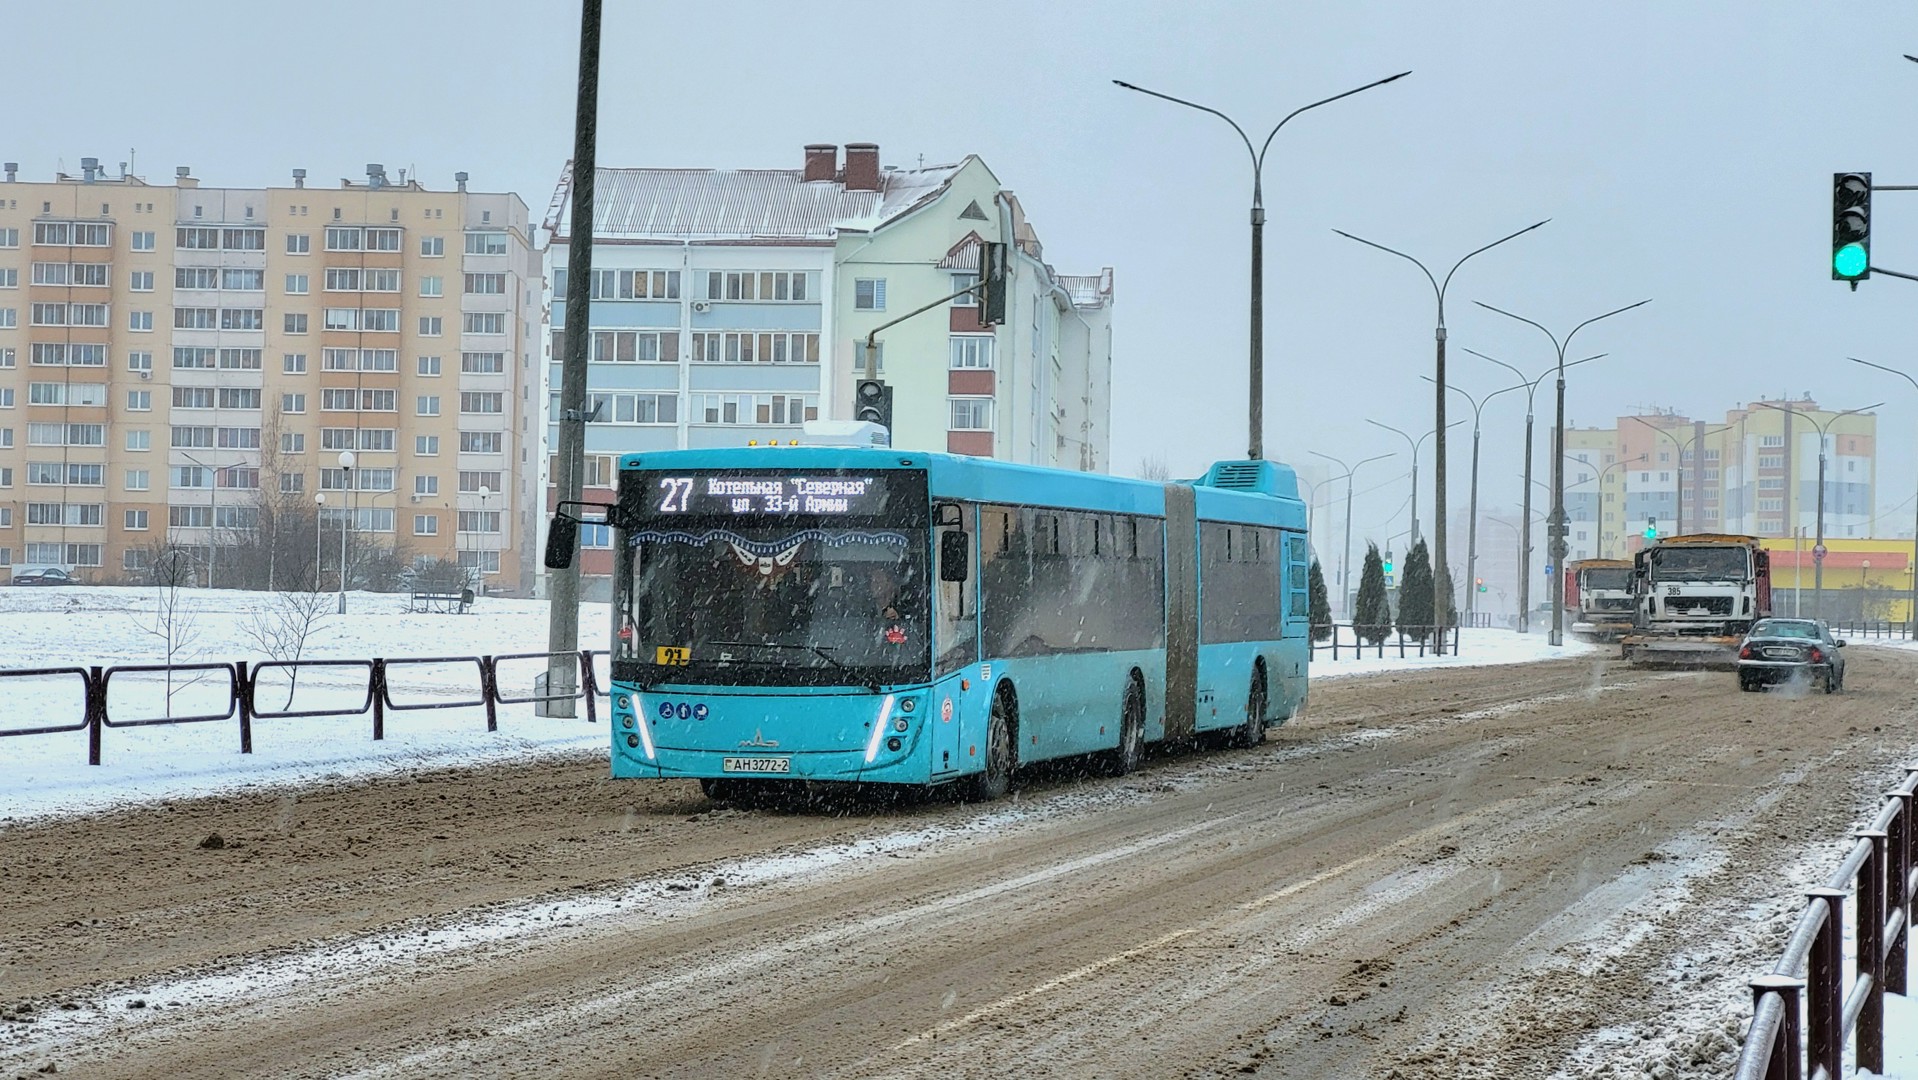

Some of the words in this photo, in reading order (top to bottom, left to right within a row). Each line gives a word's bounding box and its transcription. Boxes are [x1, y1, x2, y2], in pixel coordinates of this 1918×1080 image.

[660, 478, 693, 512] 27
[707, 478, 782, 495] Котельная
[731, 498, 755, 512] ул.
[764, 495, 798, 512] 33-й
[805, 497, 848, 512] Армии
[1667, 587, 1681, 596] 385
